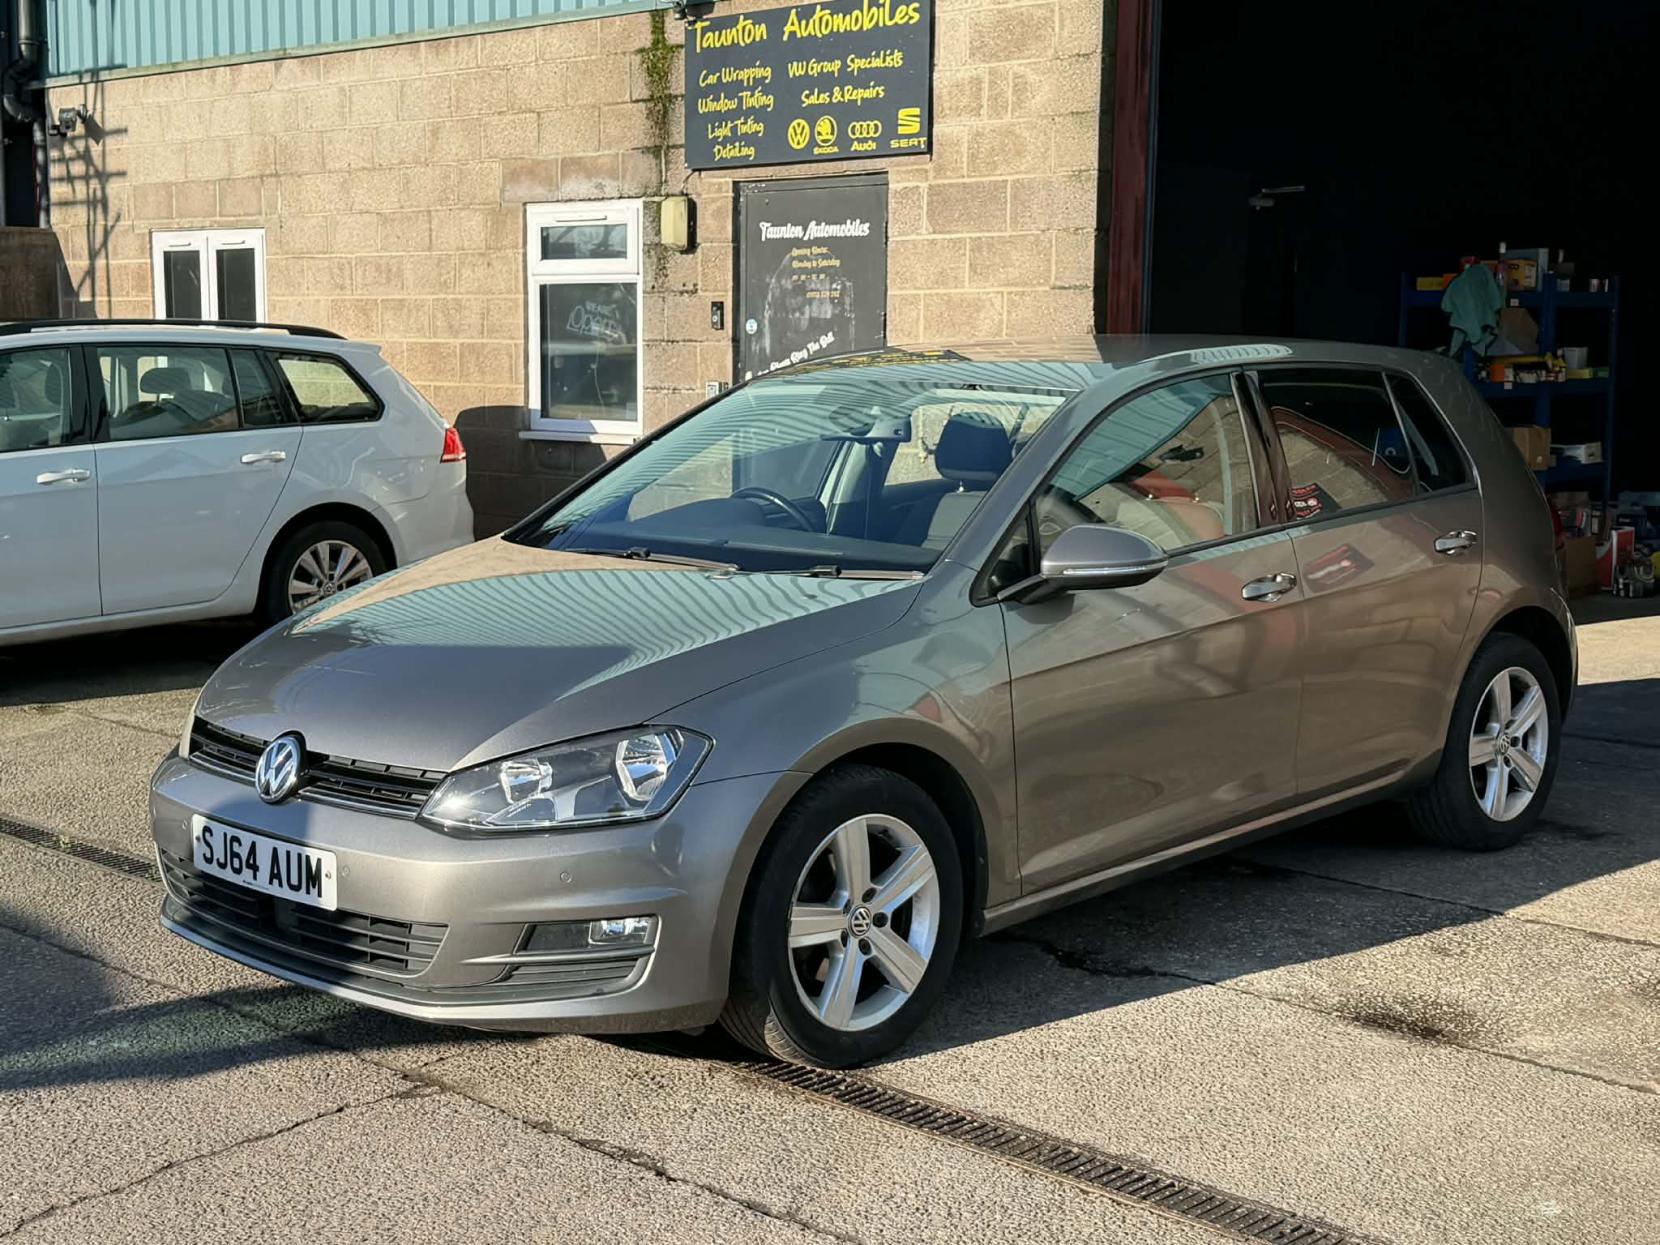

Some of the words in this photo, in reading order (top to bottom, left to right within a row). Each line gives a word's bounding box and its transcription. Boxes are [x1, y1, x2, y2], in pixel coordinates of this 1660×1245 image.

[688, 15, 767, 53] Taunton
[782, 0, 920, 42] Automobiles
[699, 70, 720, 87] Car
[721, 60, 772, 86] Wrapping
[808, 59, 841, 78] Group
[846, 49, 904, 74] Specialists
[698, 92, 738, 114] Window
[738, 86, 774, 112] Tinting
[801, 88, 830, 107] Sales
[832, 91, 844, 104] &
[844, 81, 885, 106] Repairs
[708, 120, 732, 142] Light
[733, 115, 764, 137] Tinting
[713, 141, 755, 161] Detailing
[850, 140, 877, 151] Audi
[890, 137, 927, 149] SEAT
[759, 221, 804, 242] Taunton
[803, 218, 870, 241] Automobiles
[201, 824, 260, 882] SJ64
[268, 846, 323, 899] AUM
